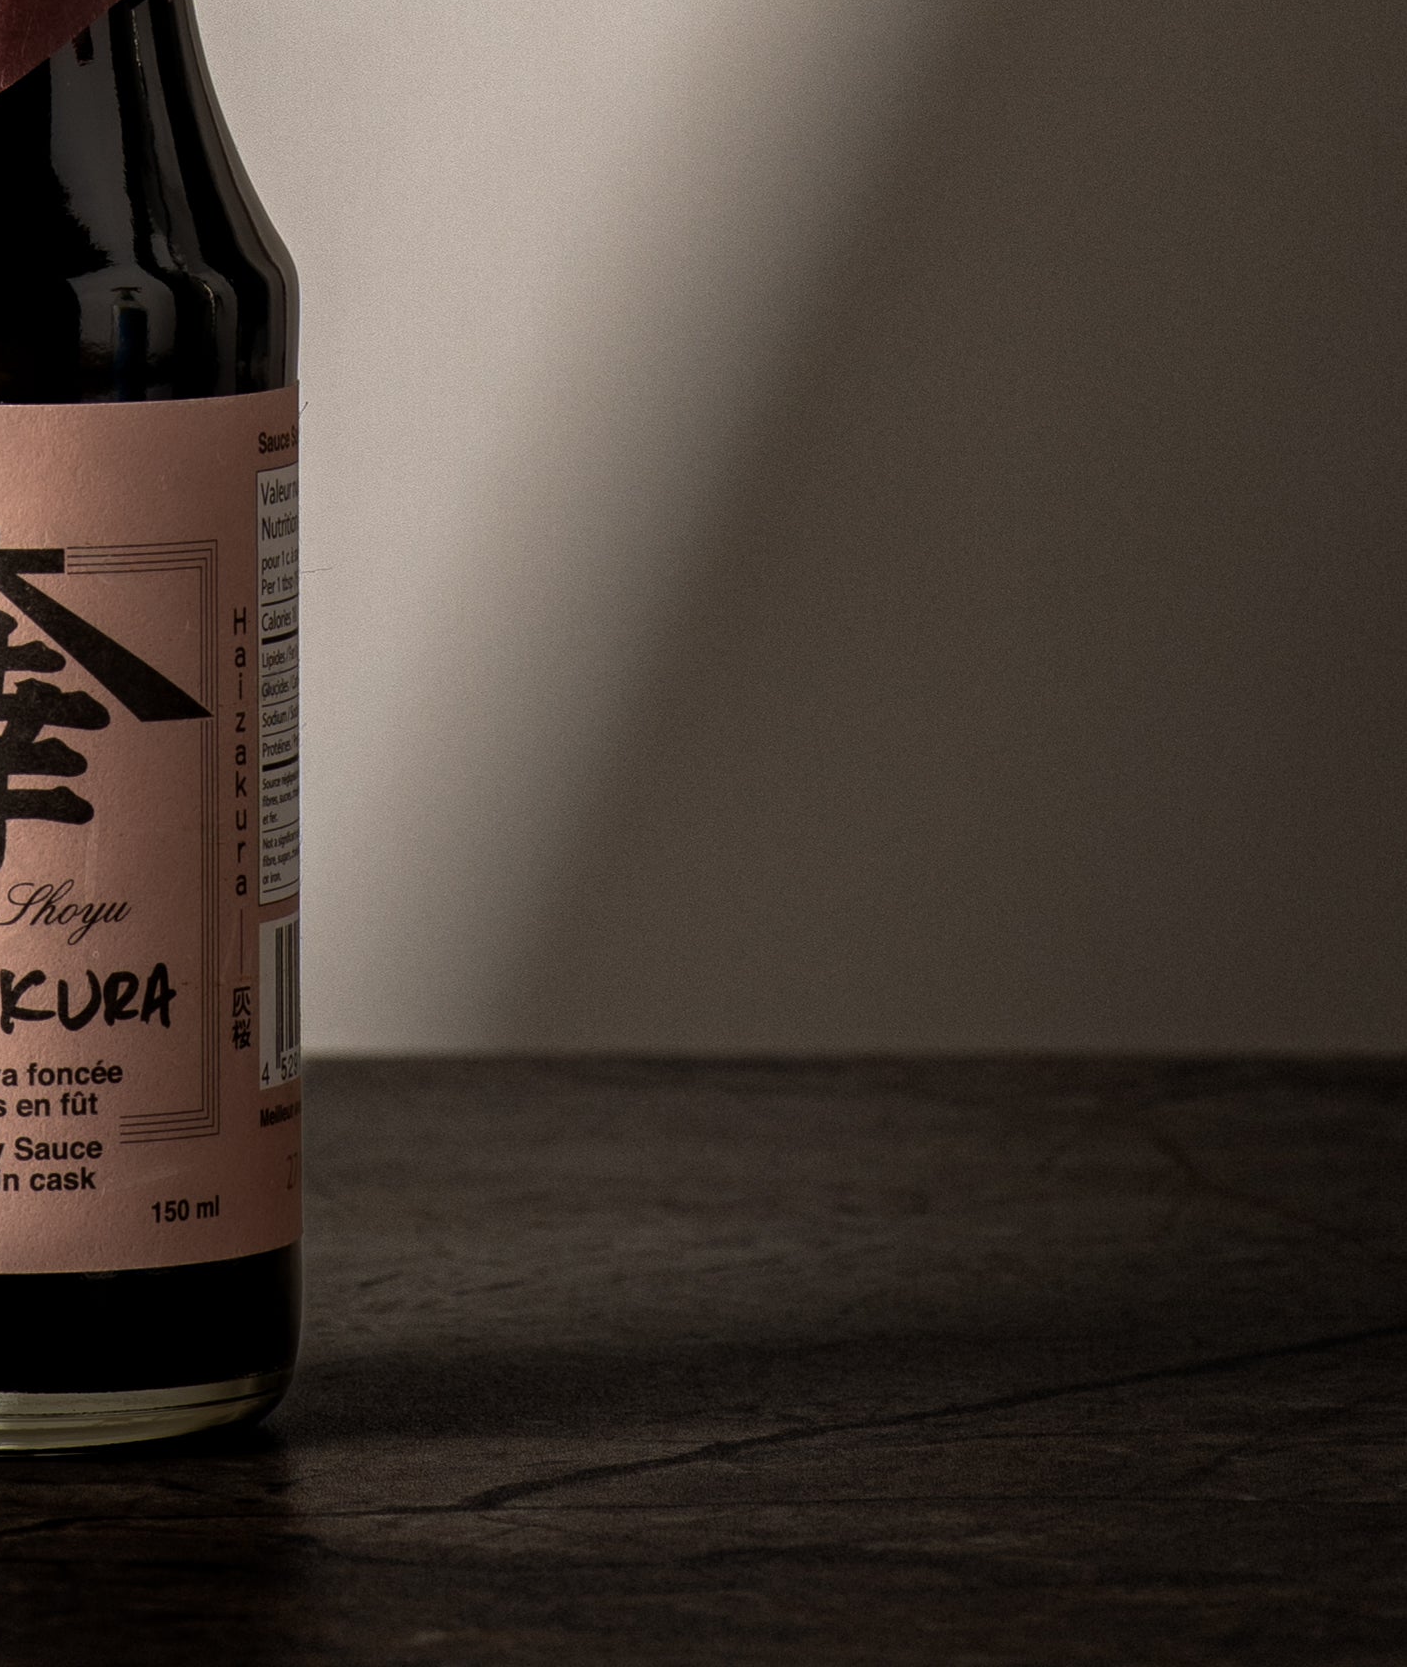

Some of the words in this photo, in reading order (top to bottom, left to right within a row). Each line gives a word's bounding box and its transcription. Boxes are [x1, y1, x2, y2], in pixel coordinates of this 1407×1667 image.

[258, 431, 290, 454] Sauce
[260, 478, 291, 506] Valeur
[261, 554, 280, 575] pour
[261, 578, 275, 595] Per
[261, 610, 291, 632] Calories
[232, 606, 249, 897] Haizakura
[26, 1057, 124, 1085] foncée
[16, 1098, 51, 1117] en
[60, 1091, 99, 1116] fût
[14, 1136, 103, 1161] Sauce
[29, 1166, 97, 1192] cask
[151, 1198, 190, 1224] 150
[196, 1195, 220, 1221] ml
